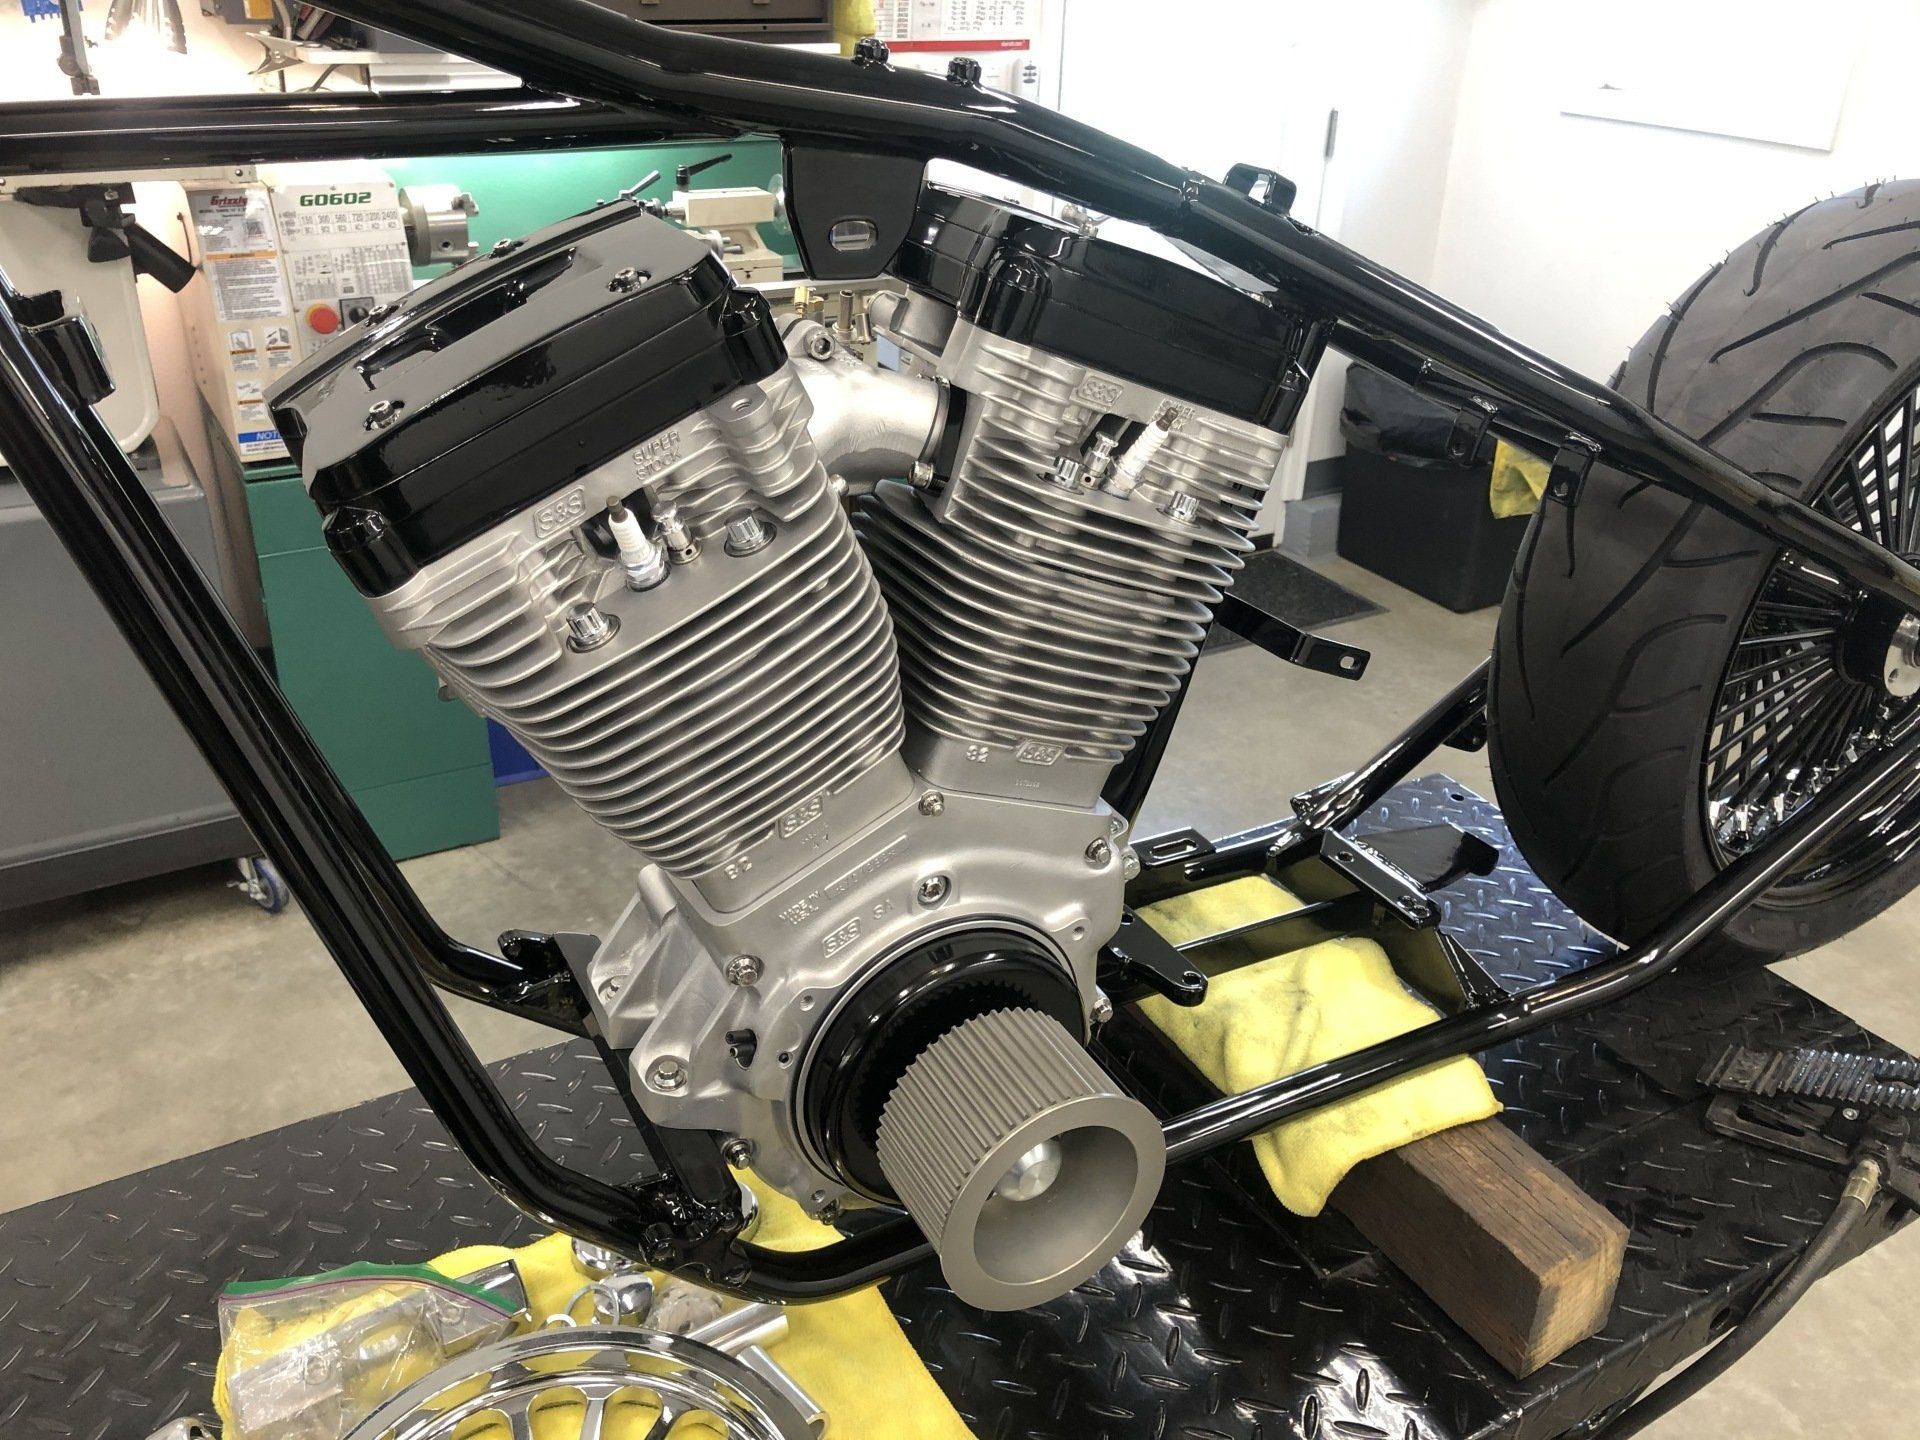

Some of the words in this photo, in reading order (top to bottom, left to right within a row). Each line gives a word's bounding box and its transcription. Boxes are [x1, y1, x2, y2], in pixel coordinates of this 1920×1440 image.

[210, 195, 248, 207] Grizzly
[632, 430, 680, 465] SUPER
[637, 449, 682, 480] STOCK
[537, 491, 584, 532] S&S
[825, 920, 859, 954] S&S
